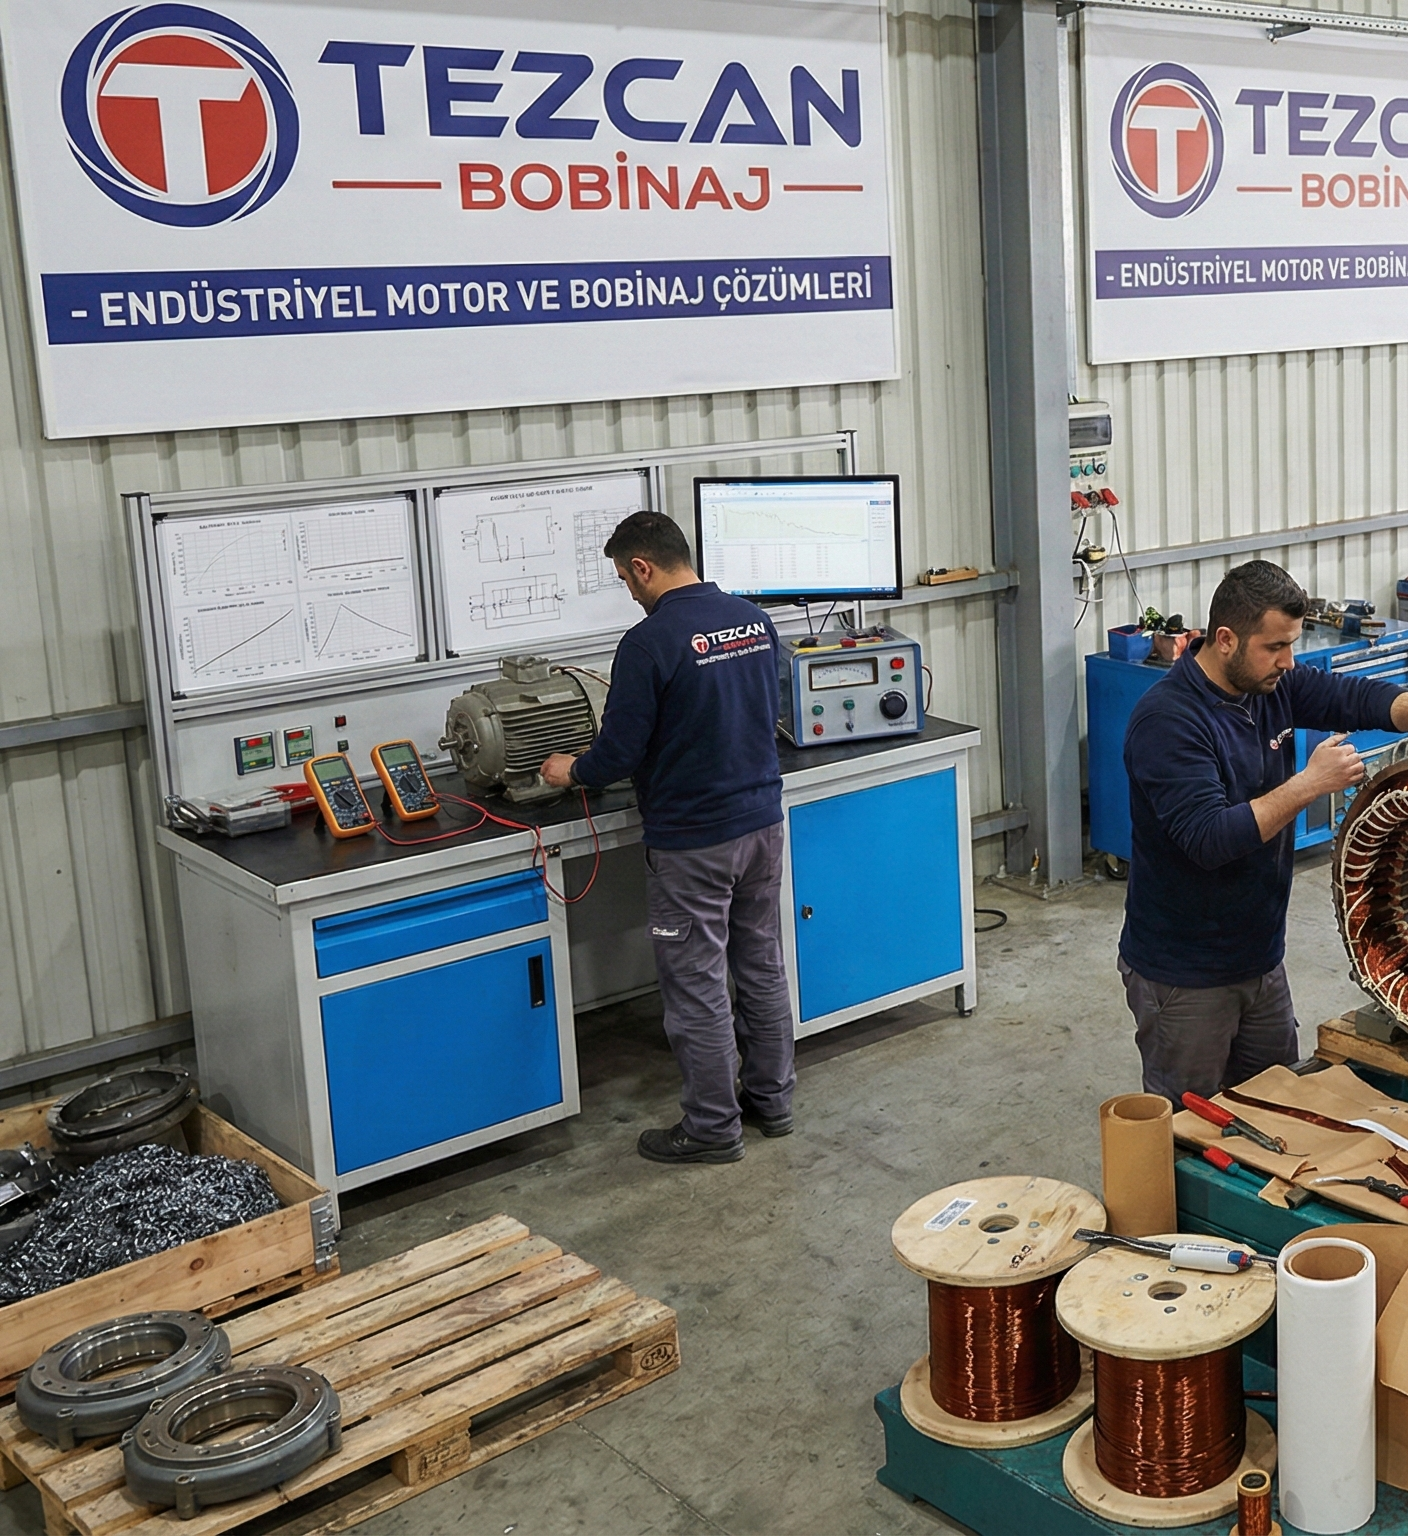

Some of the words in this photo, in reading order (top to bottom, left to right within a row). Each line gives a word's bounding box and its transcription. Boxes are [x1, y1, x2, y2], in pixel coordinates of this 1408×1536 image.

[319, 41, 862, 148] TEZCAN
[459, 152, 771, 211] BOBİNAJ
[100, 278, 377, 326] ENDÜSTRİYEL
[386, 281, 511, 316] MOTOR
[517, 279, 561, 311] VE
[570, 269, 704, 310] BOBİNAJ
[713, 263, 872, 311] ÇÖZÜMLERİ
[1120, 255, 1257, 287] ENDÜSTRİYEL
[1261, 258, 1324, 282] MOTOR
[1328, 257, 1350, 280] VE
[707, 622, 766, 645] TEZCAN
